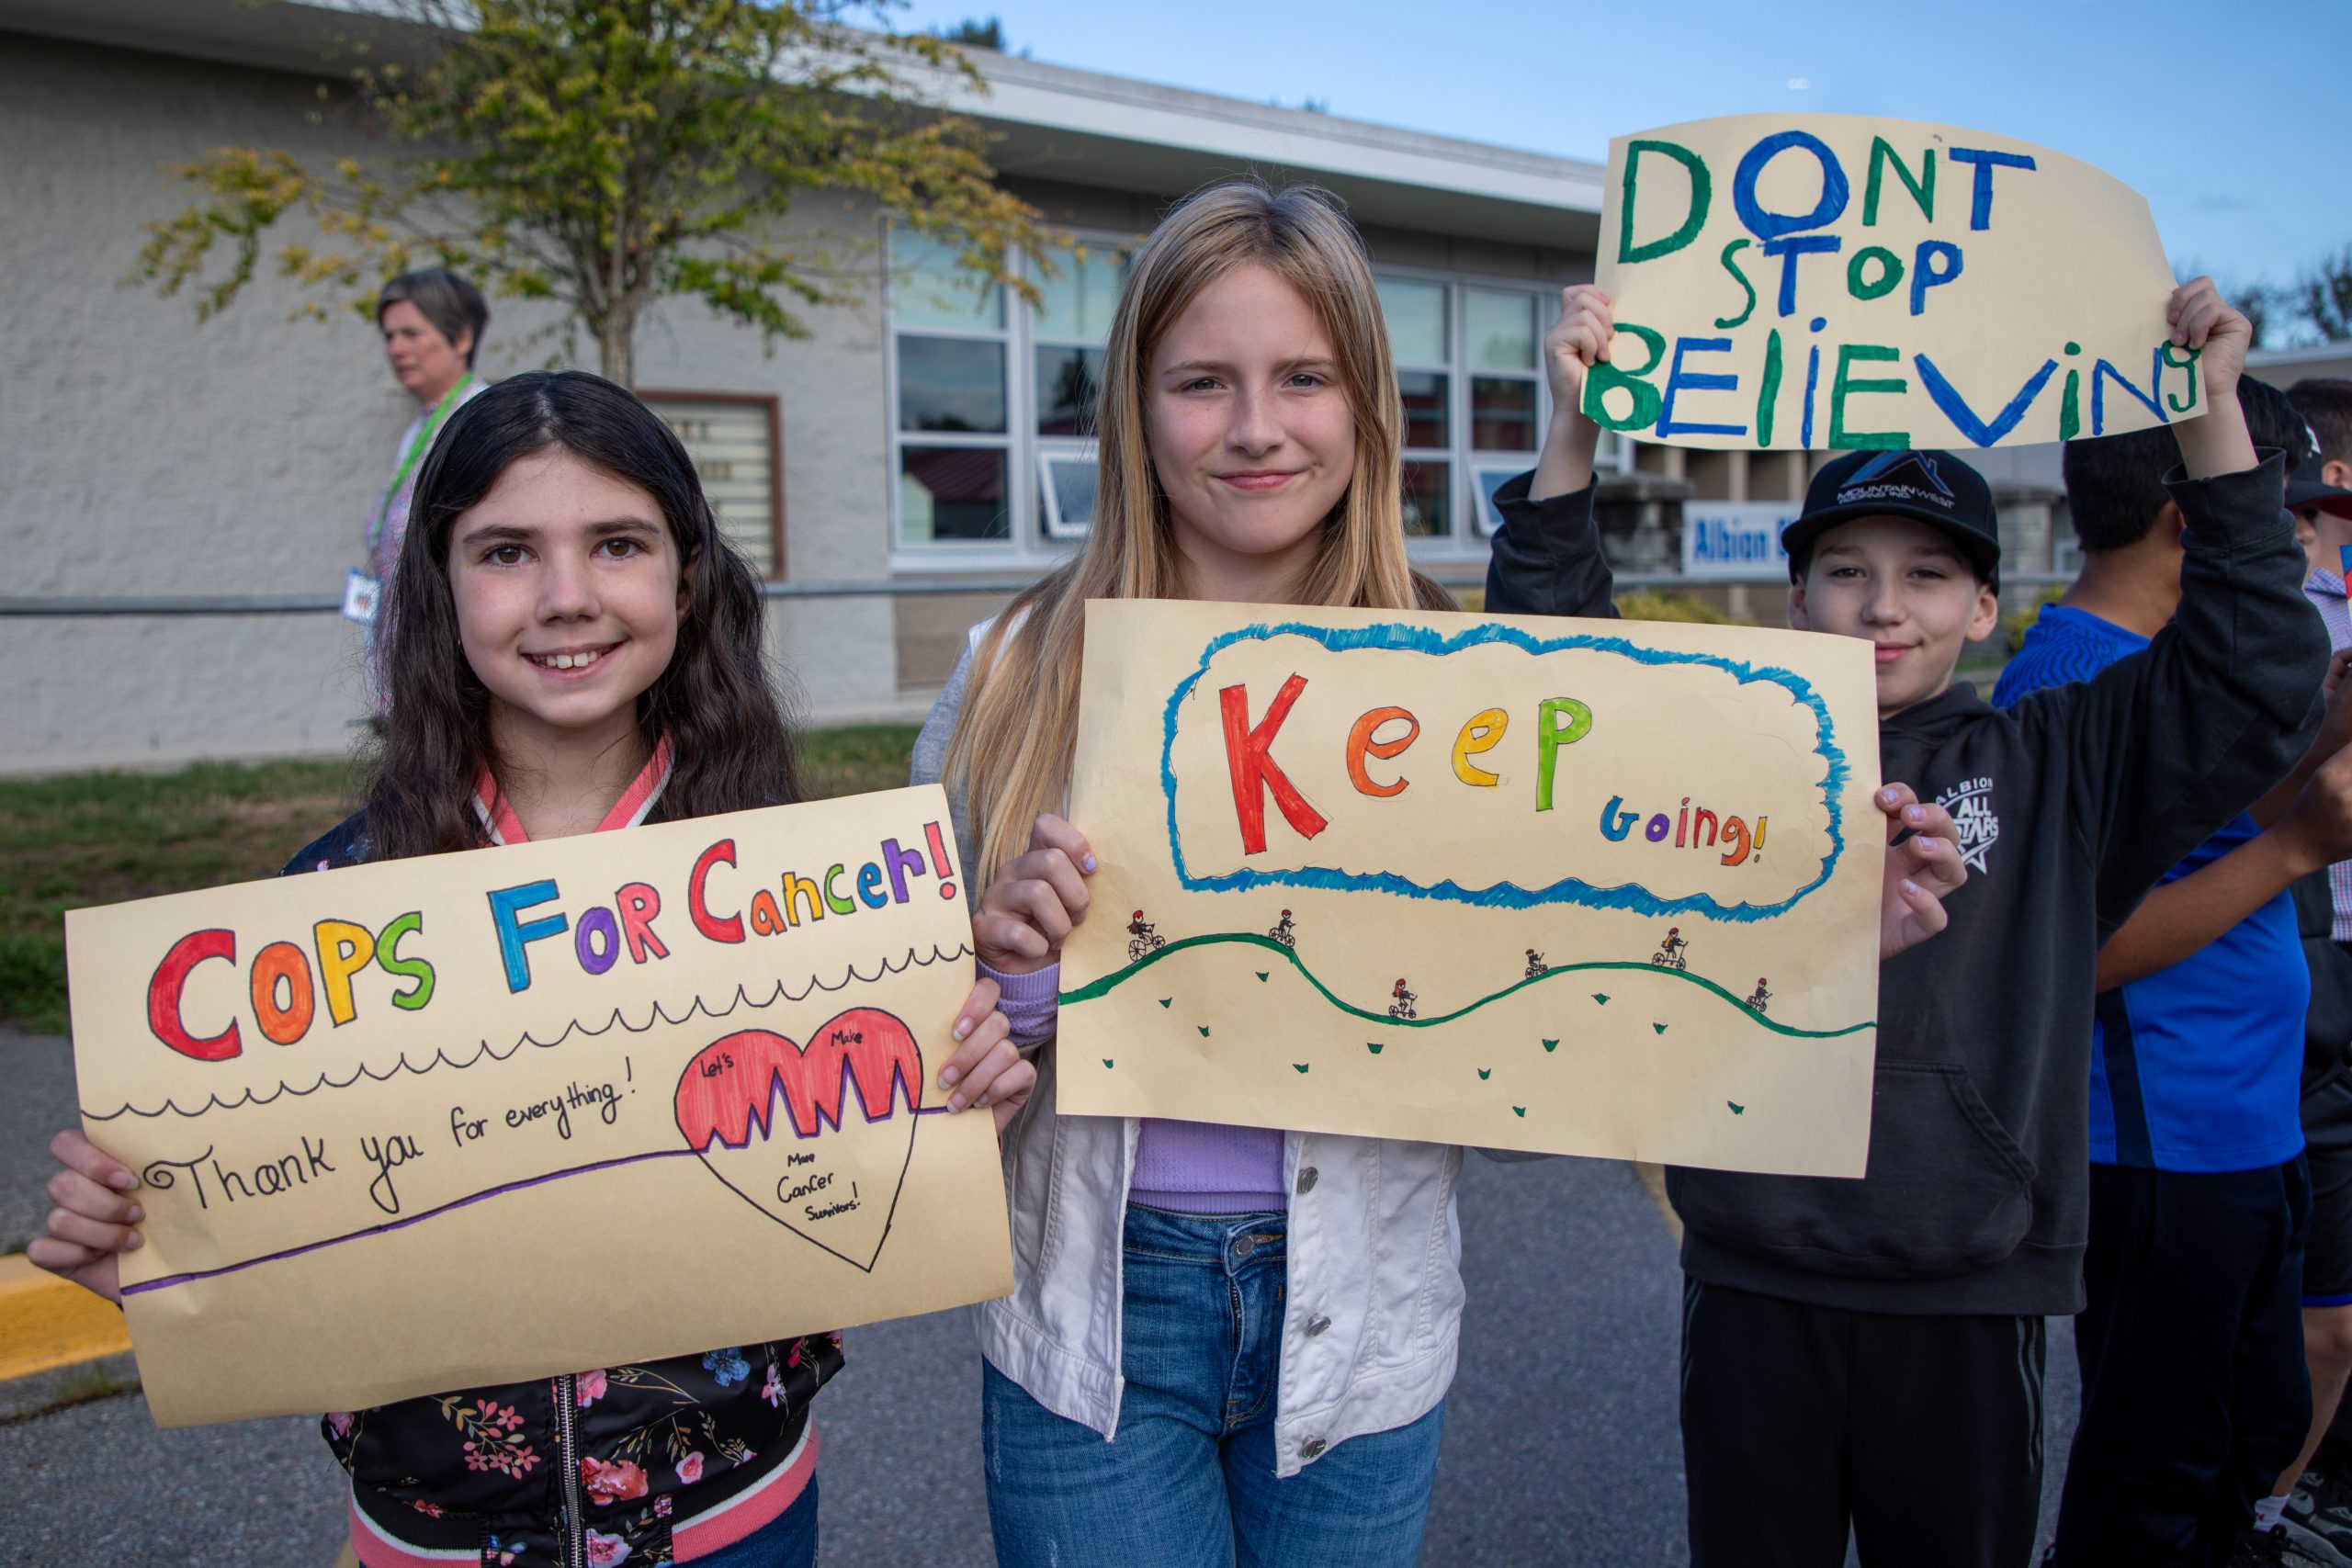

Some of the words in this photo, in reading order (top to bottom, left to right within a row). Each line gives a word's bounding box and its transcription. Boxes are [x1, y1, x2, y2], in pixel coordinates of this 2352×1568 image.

[1714, 235, 1963, 329] STOP
[1693, 518, 1768, 562] Albion
[1935, 777, 1993, 805] ALBION
[1957, 796, 1992, 818] ALL
[1600, 795, 1768, 867] Going!
[148, 910, 435, 1062] COPS
[688, 821, 957, 945] Cancer!
[701, 1053, 734, 1077] Let's
[831, 1028, 864, 1047] Make
[143, 1136, 335, 1210] Thank
[361, 1134, 424, 1213] you
[451, 1106, 489, 1147] for
[505, 1056, 637, 1139] everything!
[787, 1153, 815, 1167] More
